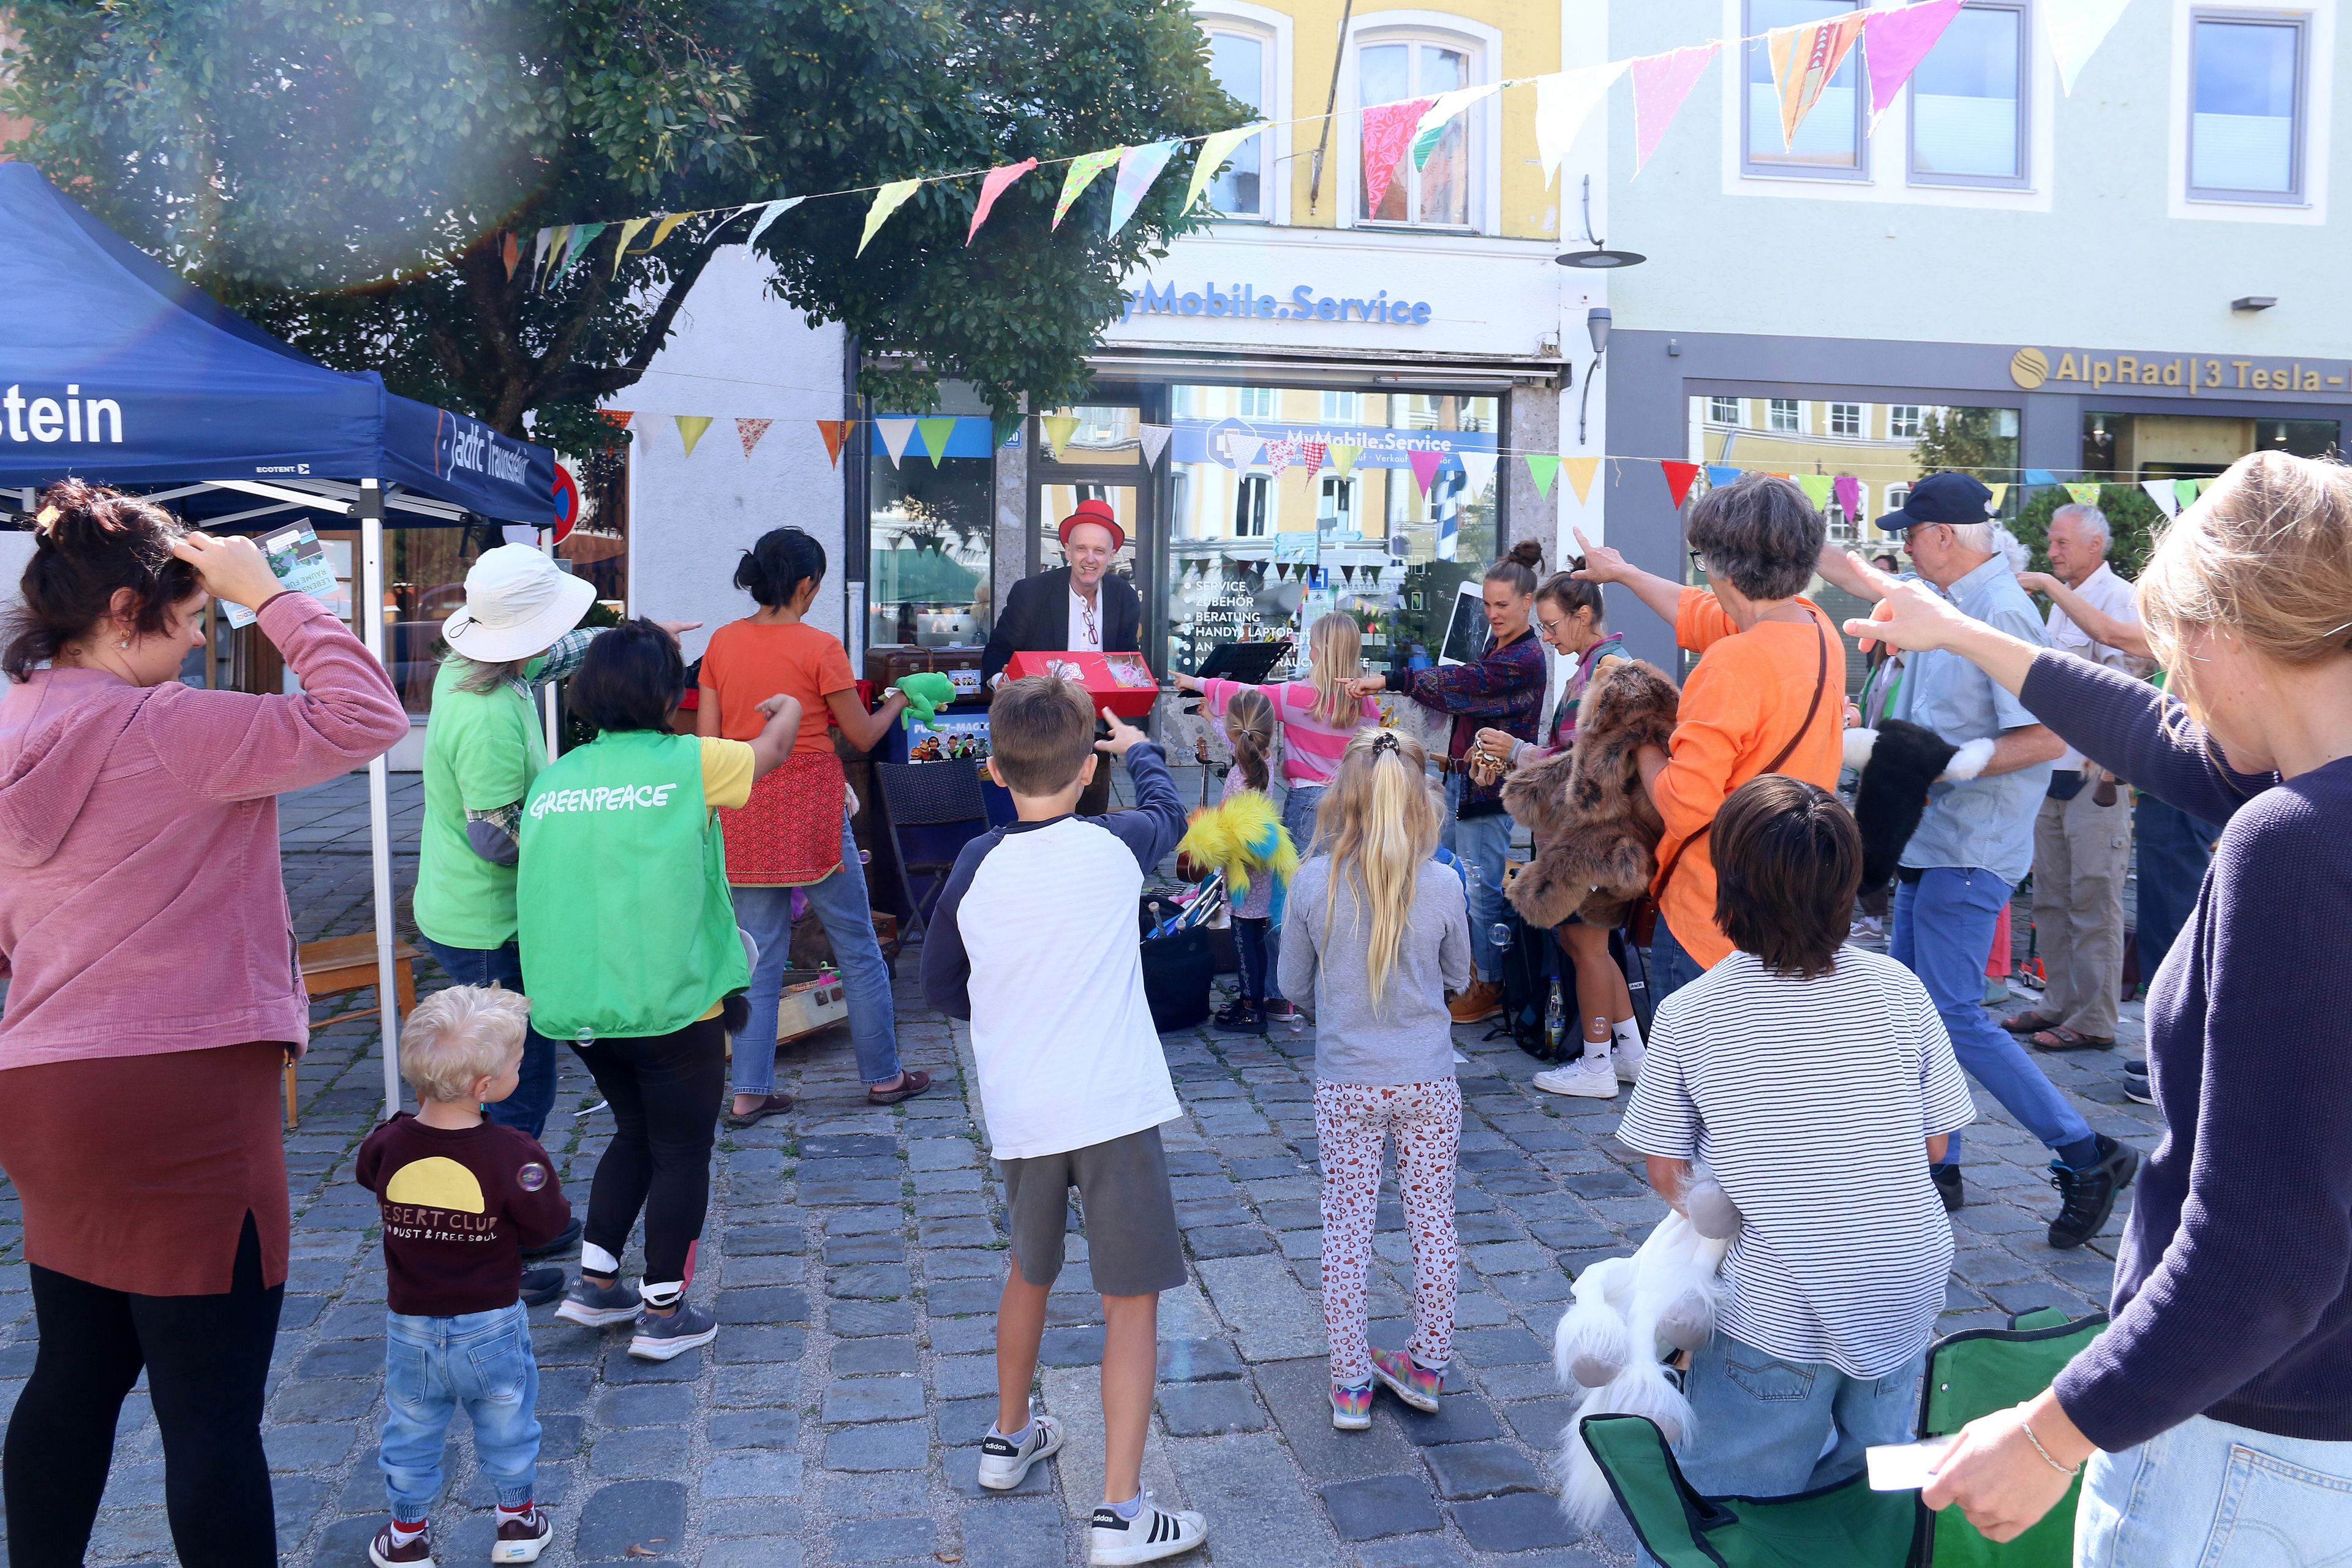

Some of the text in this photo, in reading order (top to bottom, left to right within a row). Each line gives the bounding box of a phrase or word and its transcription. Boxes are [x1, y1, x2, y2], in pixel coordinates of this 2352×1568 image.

[1120, 279, 1431, 325] yMobile.Service
[2232, 361, 2320, 391] Tesla
[0, 384, 123, 443] tein
[455, 423, 485, 472] adfc
[1287, 430, 1452, 452] MyMobile.Service
[1375, 454, 1409, 462] Verkauf
[1196, 581, 1246, 592] SERVICE
[1196, 595, 1254, 607] ZUBEHÖR
[1196, 612, 1261, 622] BERATUNG
[1196, 627, 1239, 637] HANDY
[1248, 627, 1294, 637] LAPTOP
[530, 783, 677, 820] GREENPEACE
[383, 1205, 445, 1227] ESERT
[394, 1227, 421, 1239] DUST
[425, 1229, 432, 1239] &
[435, 1232, 466, 1241] FREE
[469, 1232, 497, 1242] SOUL
